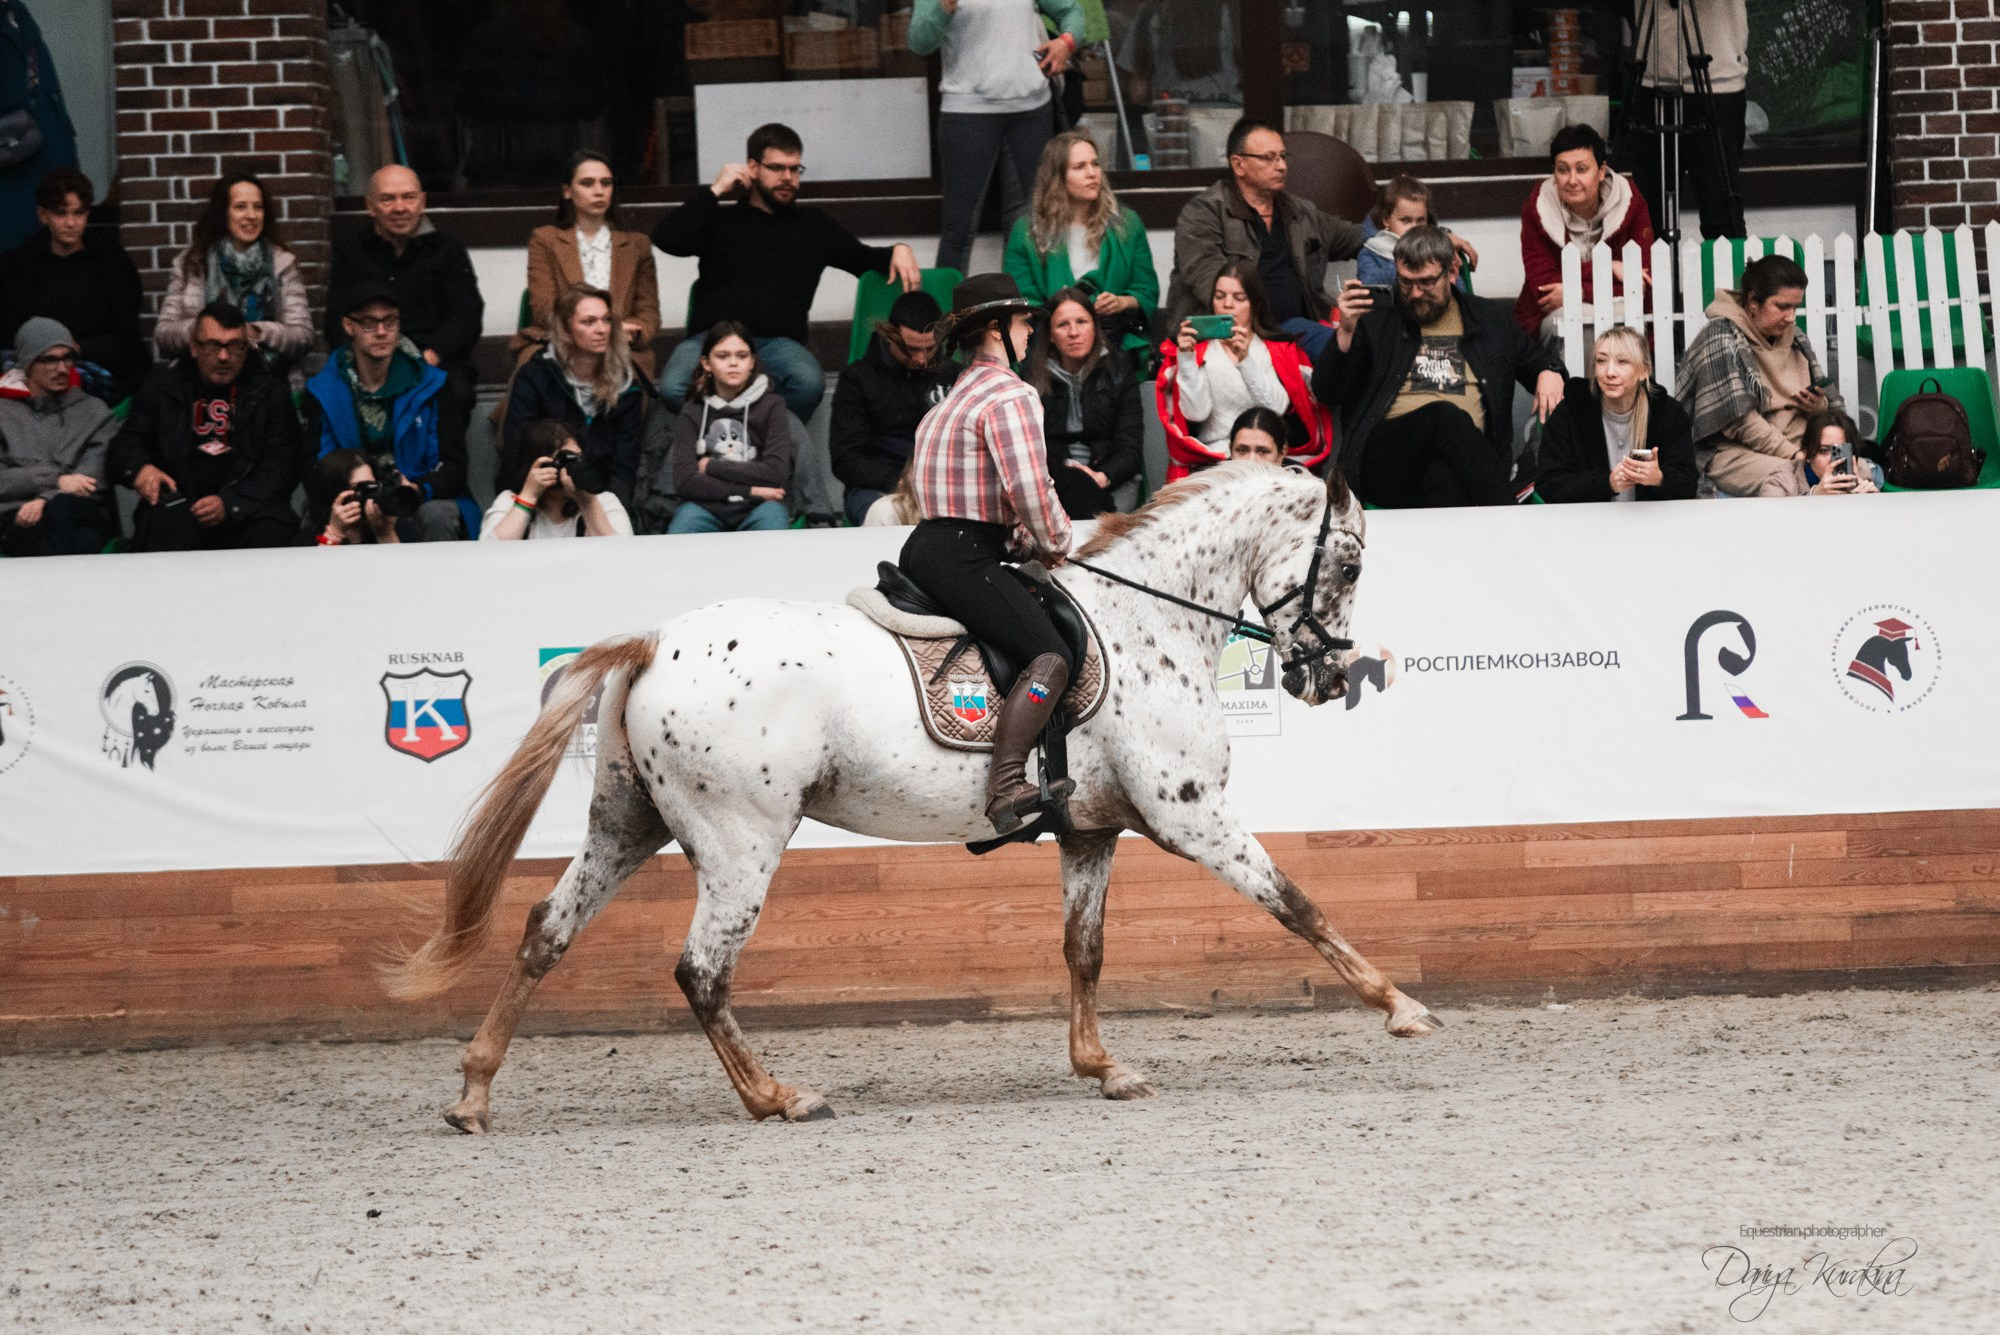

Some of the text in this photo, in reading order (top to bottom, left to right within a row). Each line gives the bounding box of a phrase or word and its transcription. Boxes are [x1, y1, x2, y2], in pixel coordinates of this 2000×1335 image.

[388, 651, 465, 665] RUSKNAB
[1404, 650, 1621, 673] РОСПЛЕМКОНЗАВОД
[199, 674, 295, 690] Мастерская
[252, 695, 308, 710] Кобыла
[956, 687, 983, 716] K
[1221, 699, 1268, 710] MAXIMA
[400, 681, 461, 743] K
